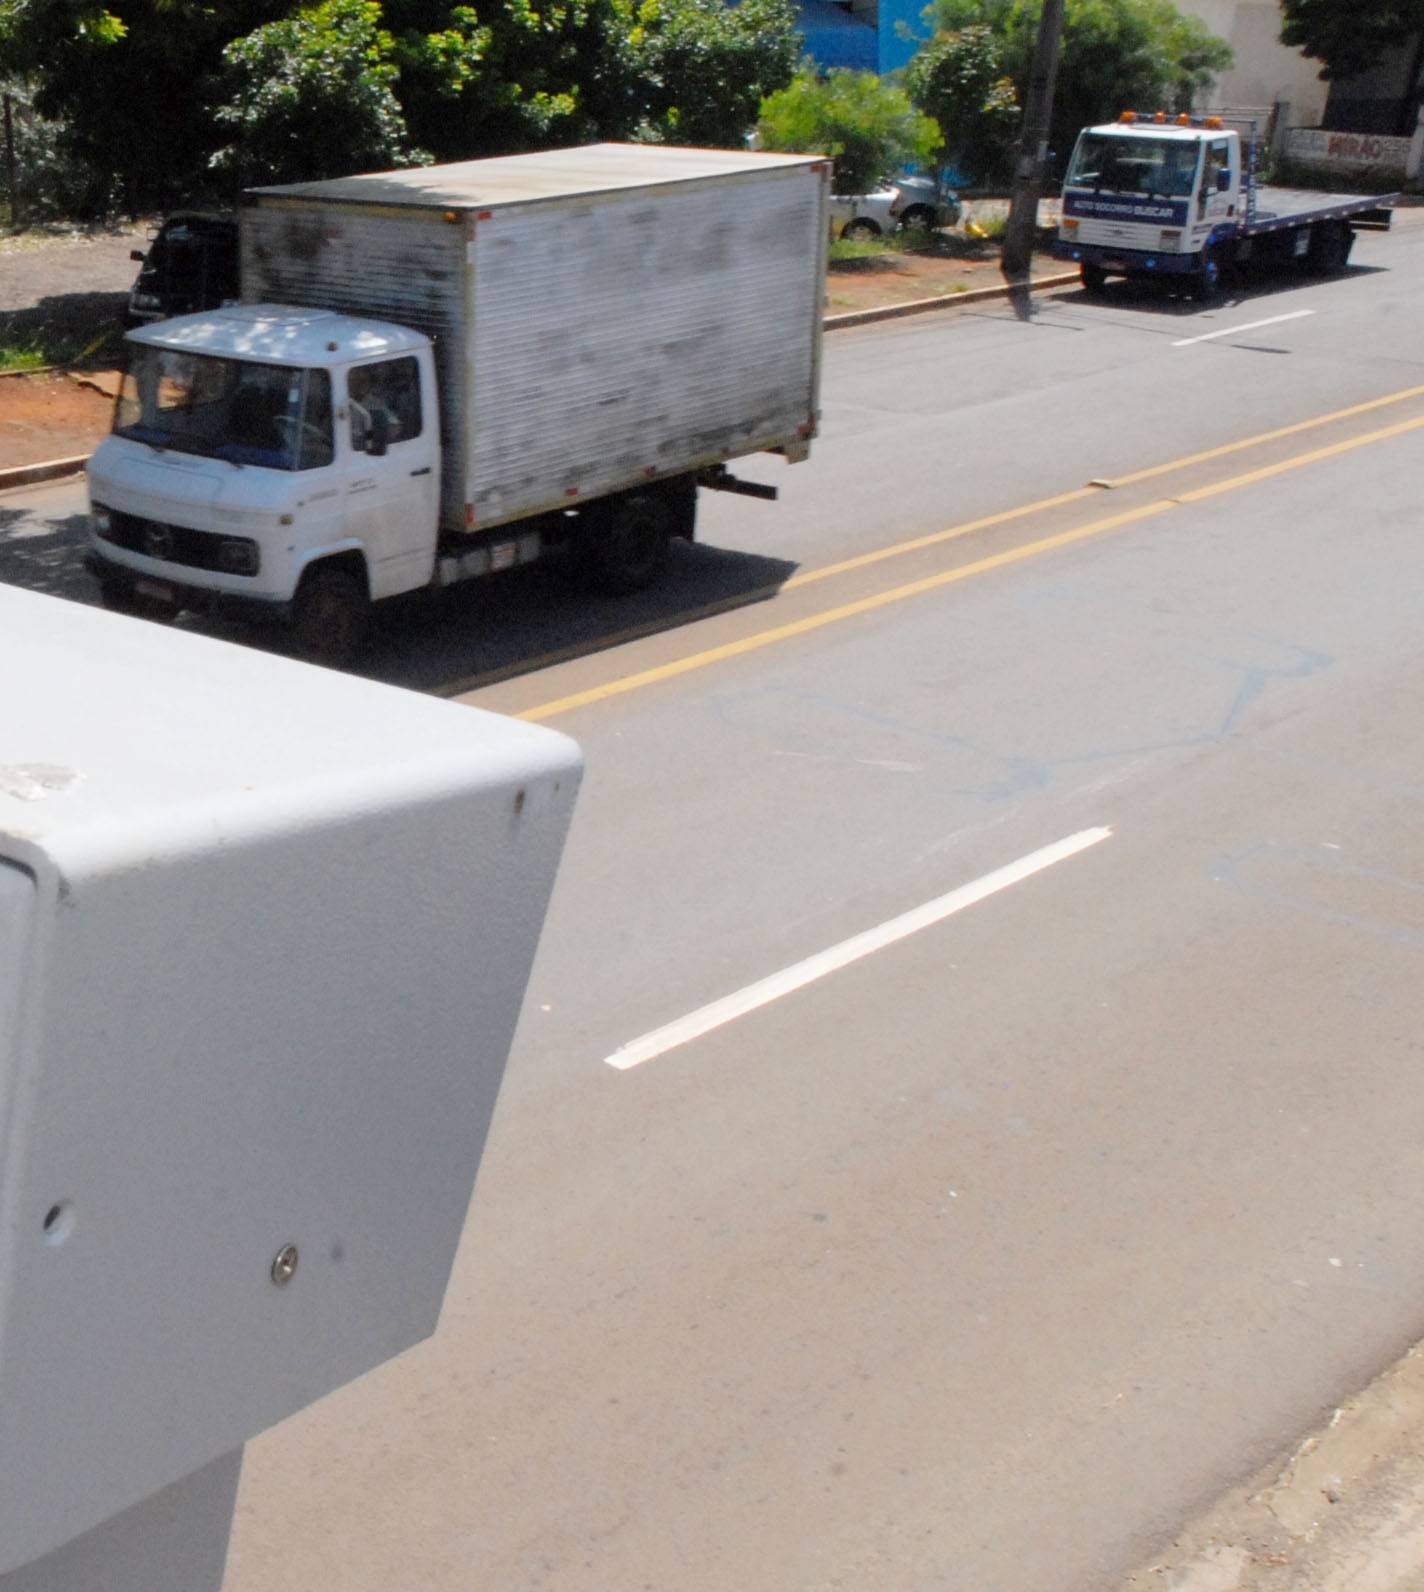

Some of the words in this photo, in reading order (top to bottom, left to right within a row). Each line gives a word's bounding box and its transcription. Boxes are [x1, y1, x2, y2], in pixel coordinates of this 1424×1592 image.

[1073, 200, 1093, 210] AUTO
[1095, 201, 1134, 214] SOCORRO
[1134, 205, 1174, 218] BUSCAR
